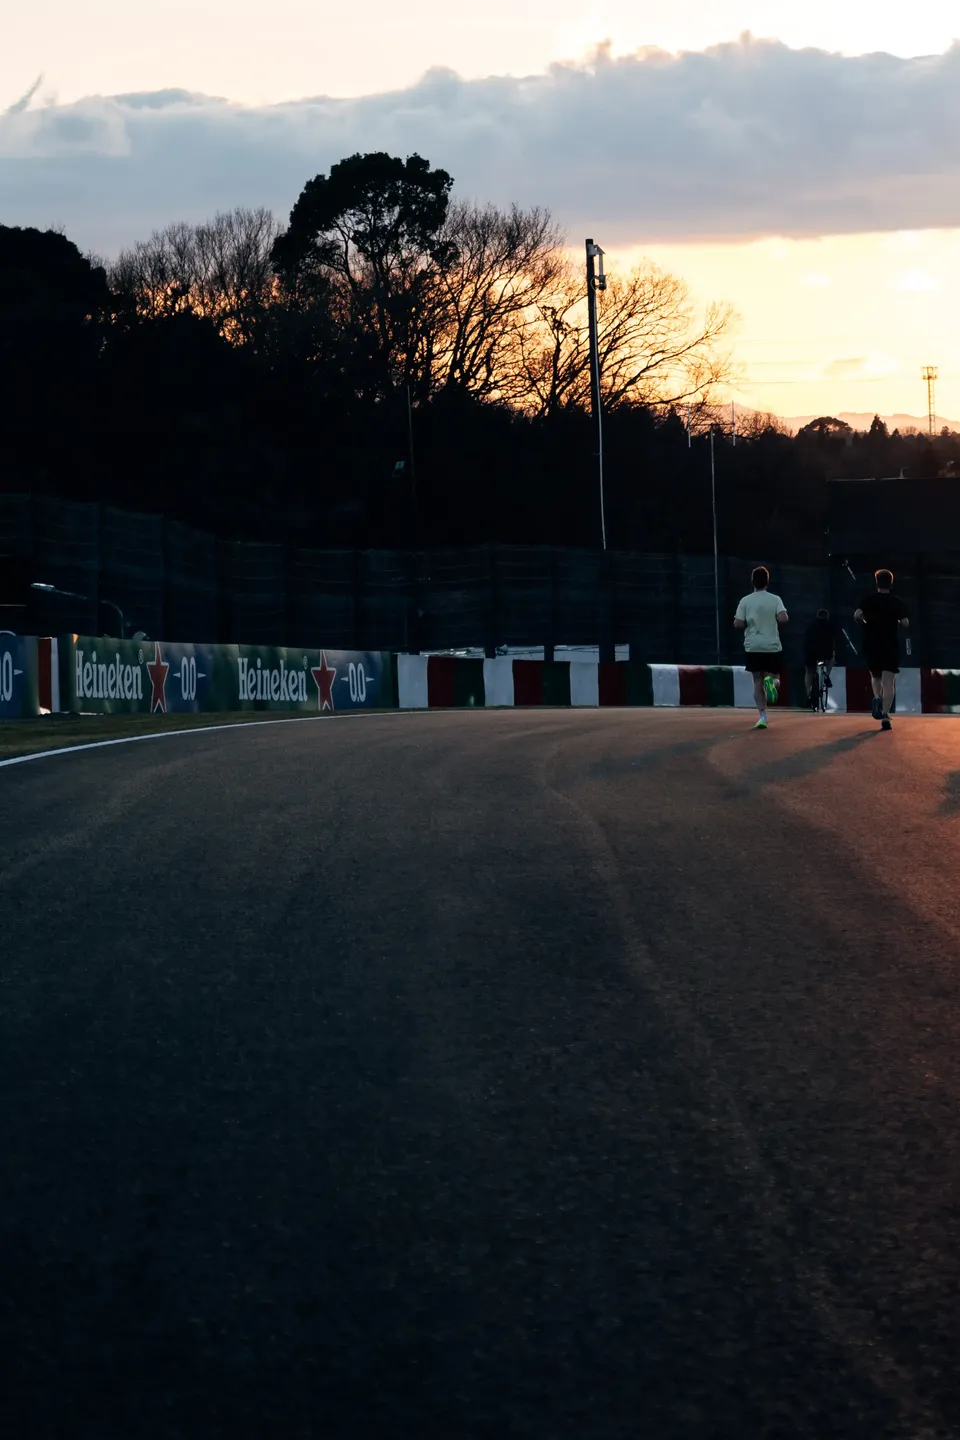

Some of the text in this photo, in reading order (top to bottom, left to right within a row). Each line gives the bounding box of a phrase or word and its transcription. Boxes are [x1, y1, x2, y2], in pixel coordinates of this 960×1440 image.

[0, 651, 13, 702] .0
[181, 656, 197, 701] 0.0
[348, 663, 366, 702] 0.0
